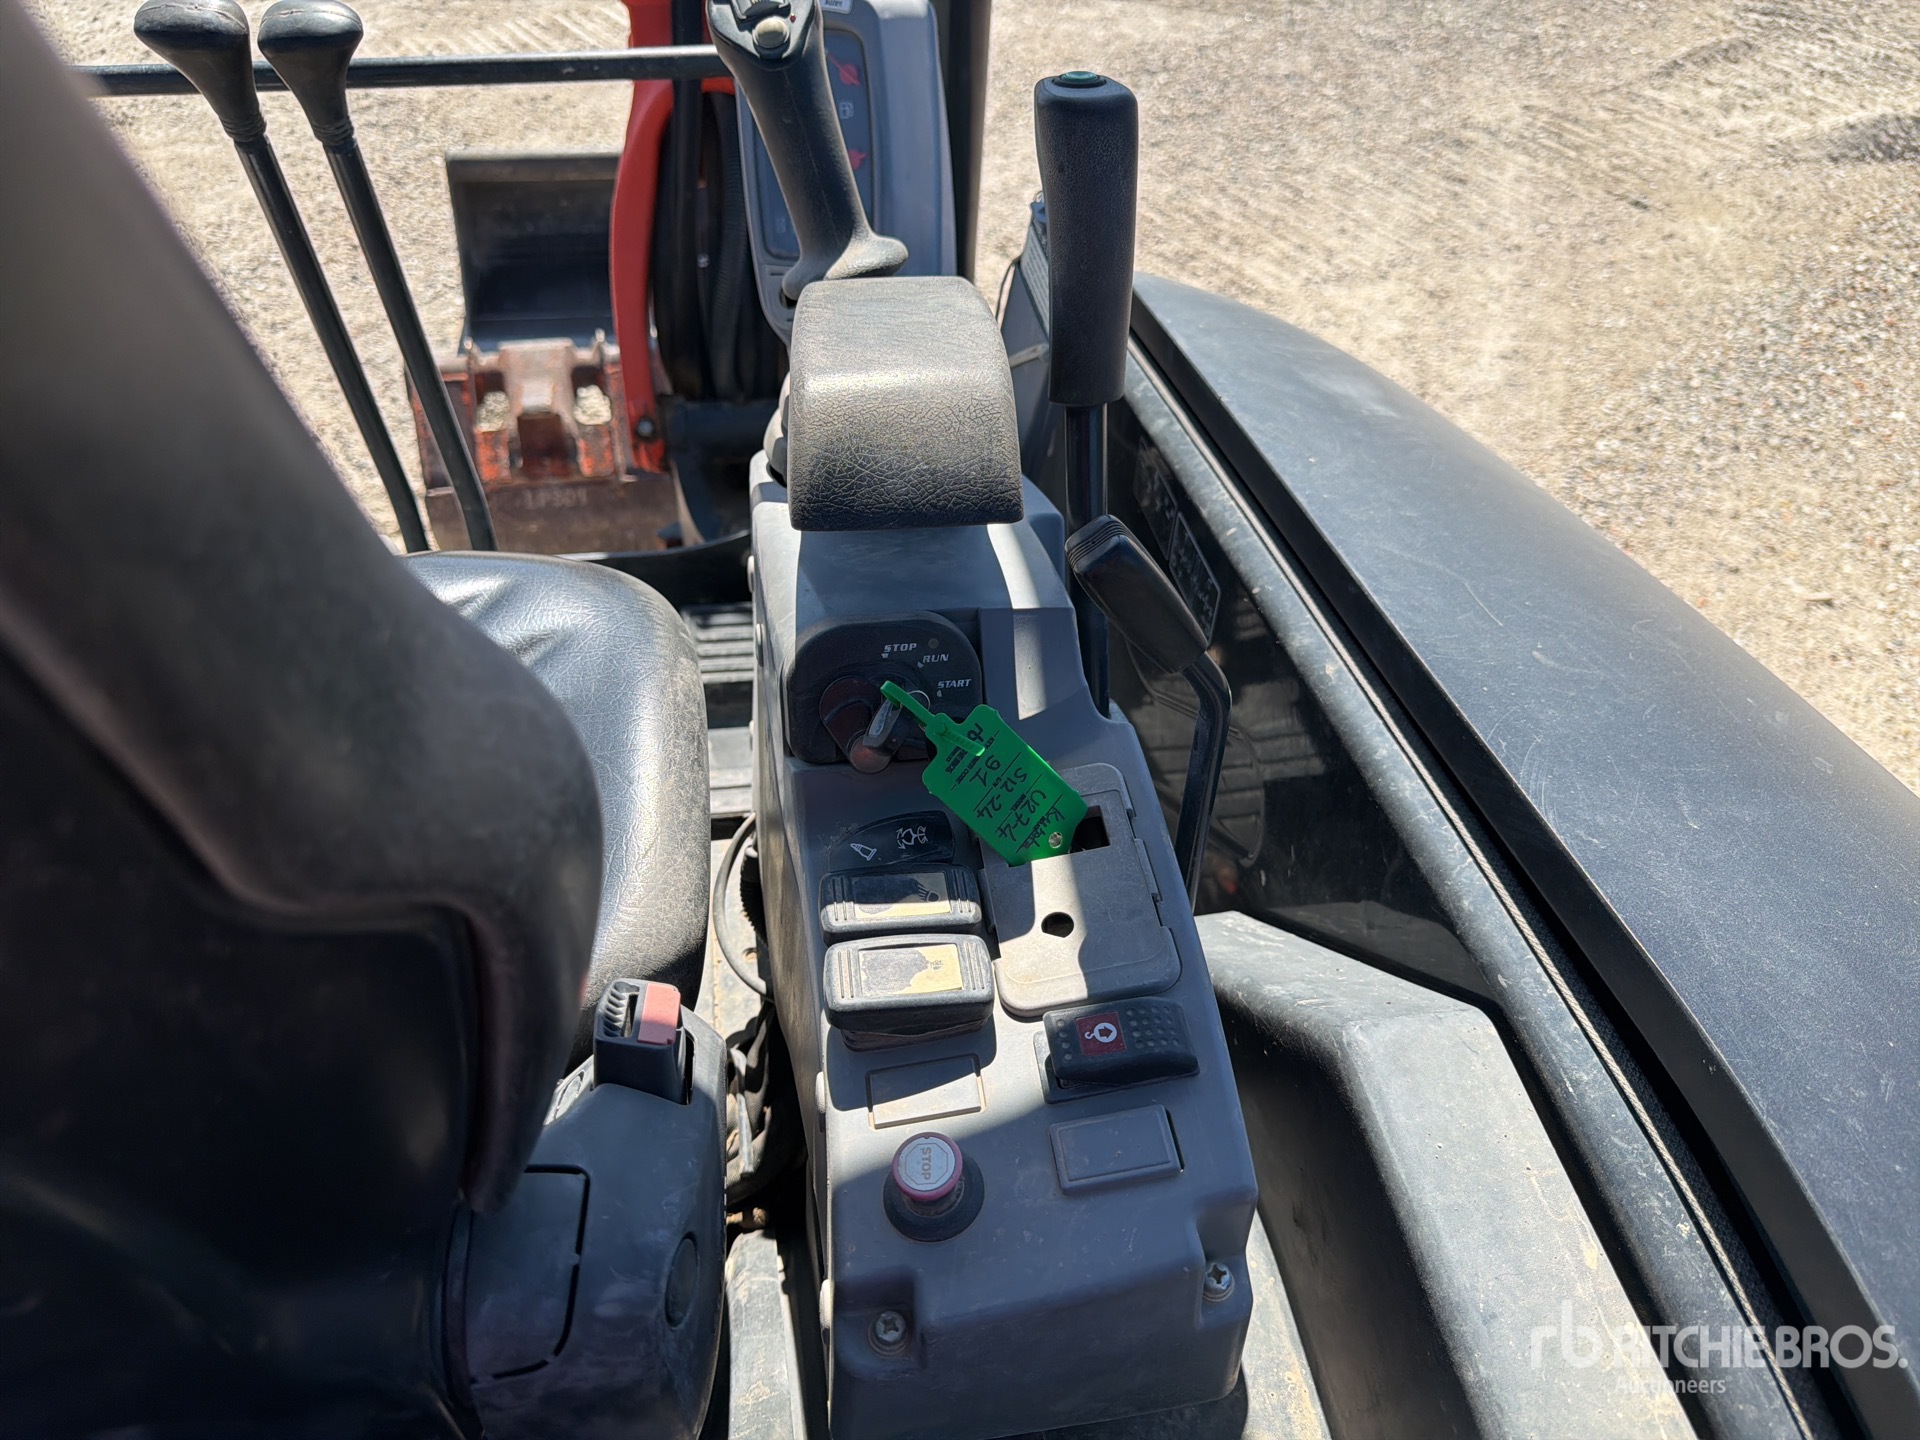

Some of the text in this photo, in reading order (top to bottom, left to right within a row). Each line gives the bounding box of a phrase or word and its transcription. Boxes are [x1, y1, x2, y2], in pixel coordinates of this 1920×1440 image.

[883, 642, 917, 653] STOP
[922, 653, 949, 663] RUN
[937, 678, 972, 689] START
[921, 1146, 931, 1180] STOP
